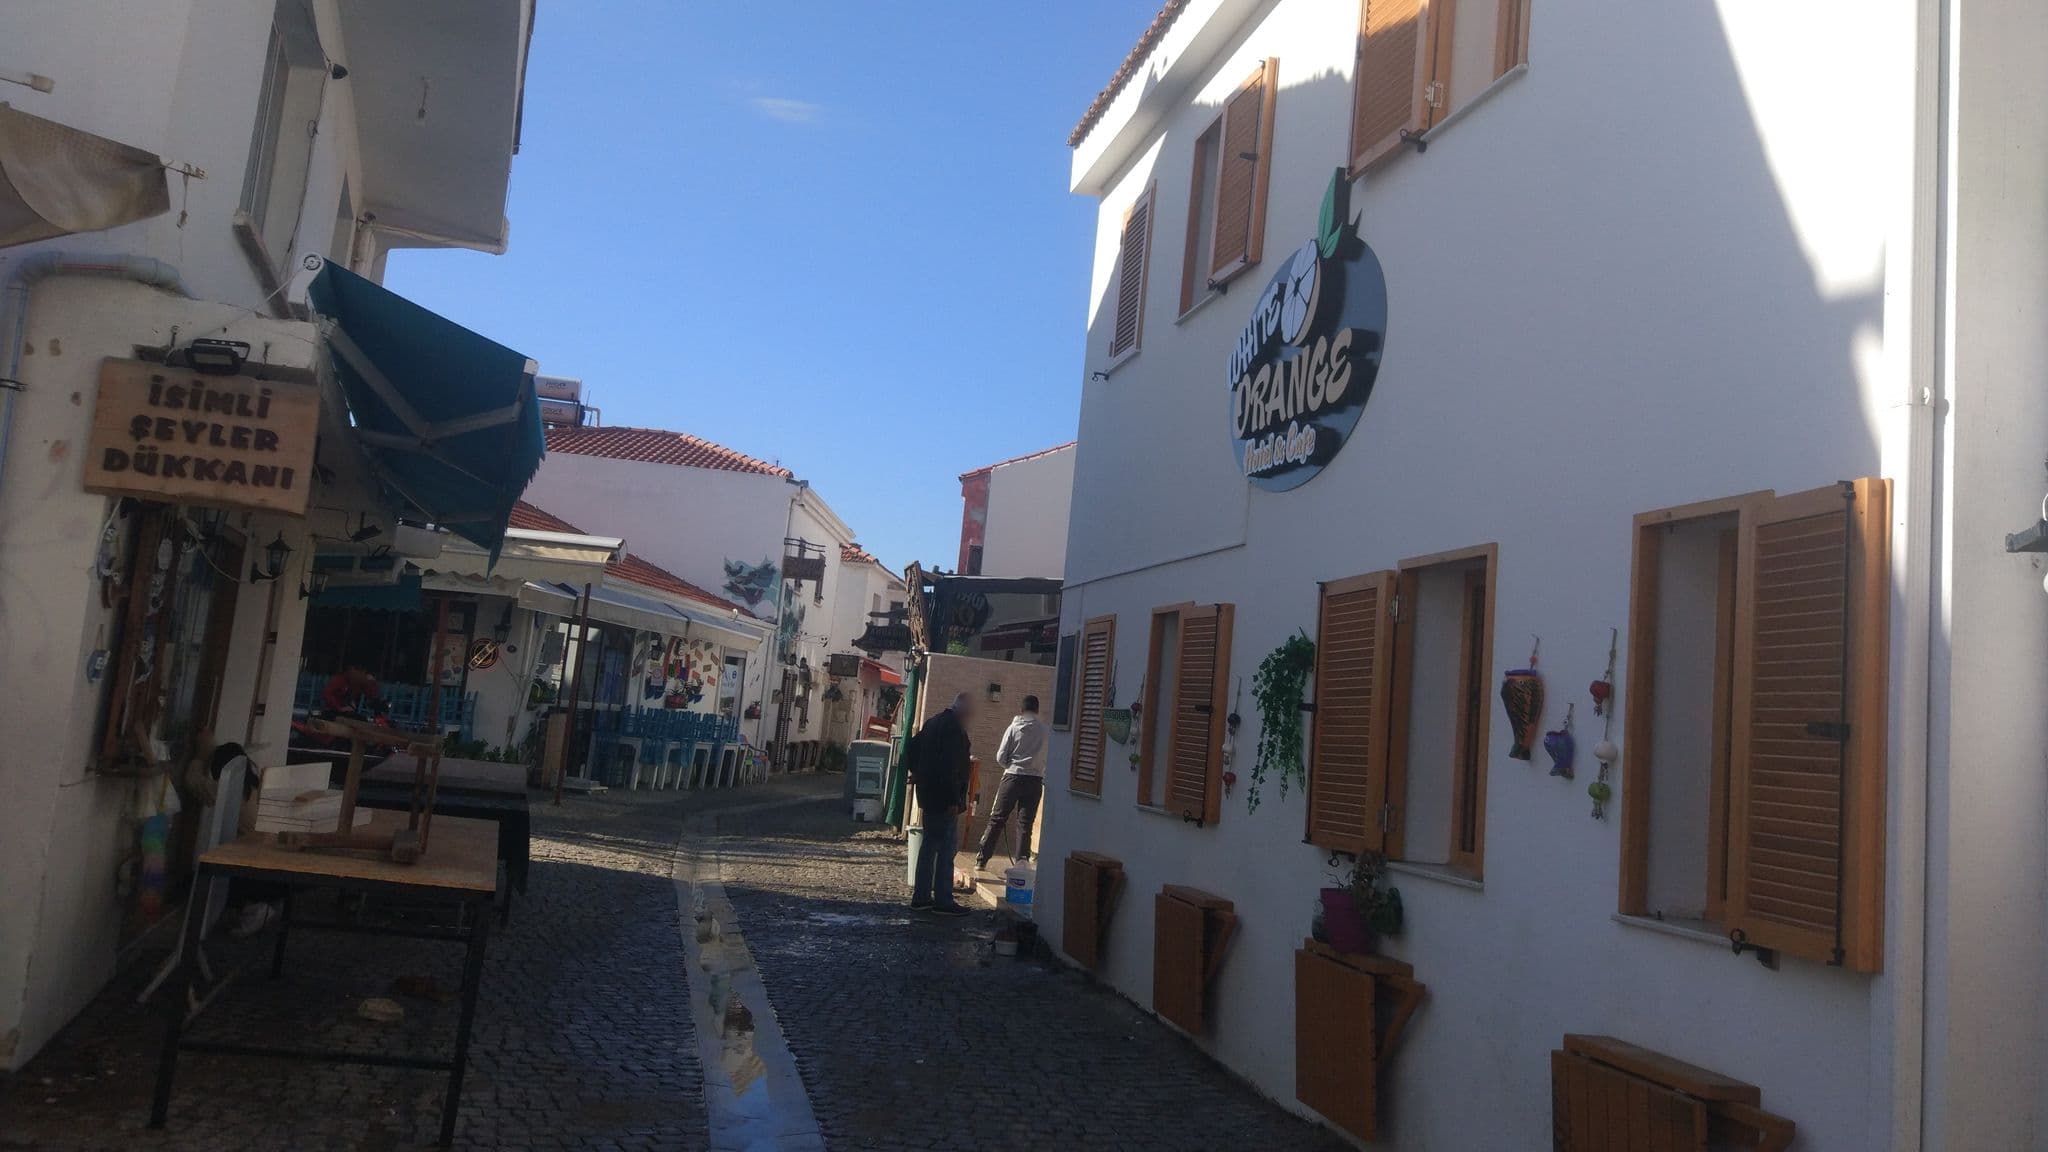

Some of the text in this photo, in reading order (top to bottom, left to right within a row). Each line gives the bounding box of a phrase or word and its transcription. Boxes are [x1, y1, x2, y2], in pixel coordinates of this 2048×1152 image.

[1227, 281, 1281, 389] WHITE
[148, 374, 273, 419] İSİMLİ
[1235, 327, 1352, 439] ORANGE
[129, 415, 279, 453] ŞEYLER
[1285, 420, 1316, 464] Cafe
[103, 444, 295, 489] DÜKKANI
